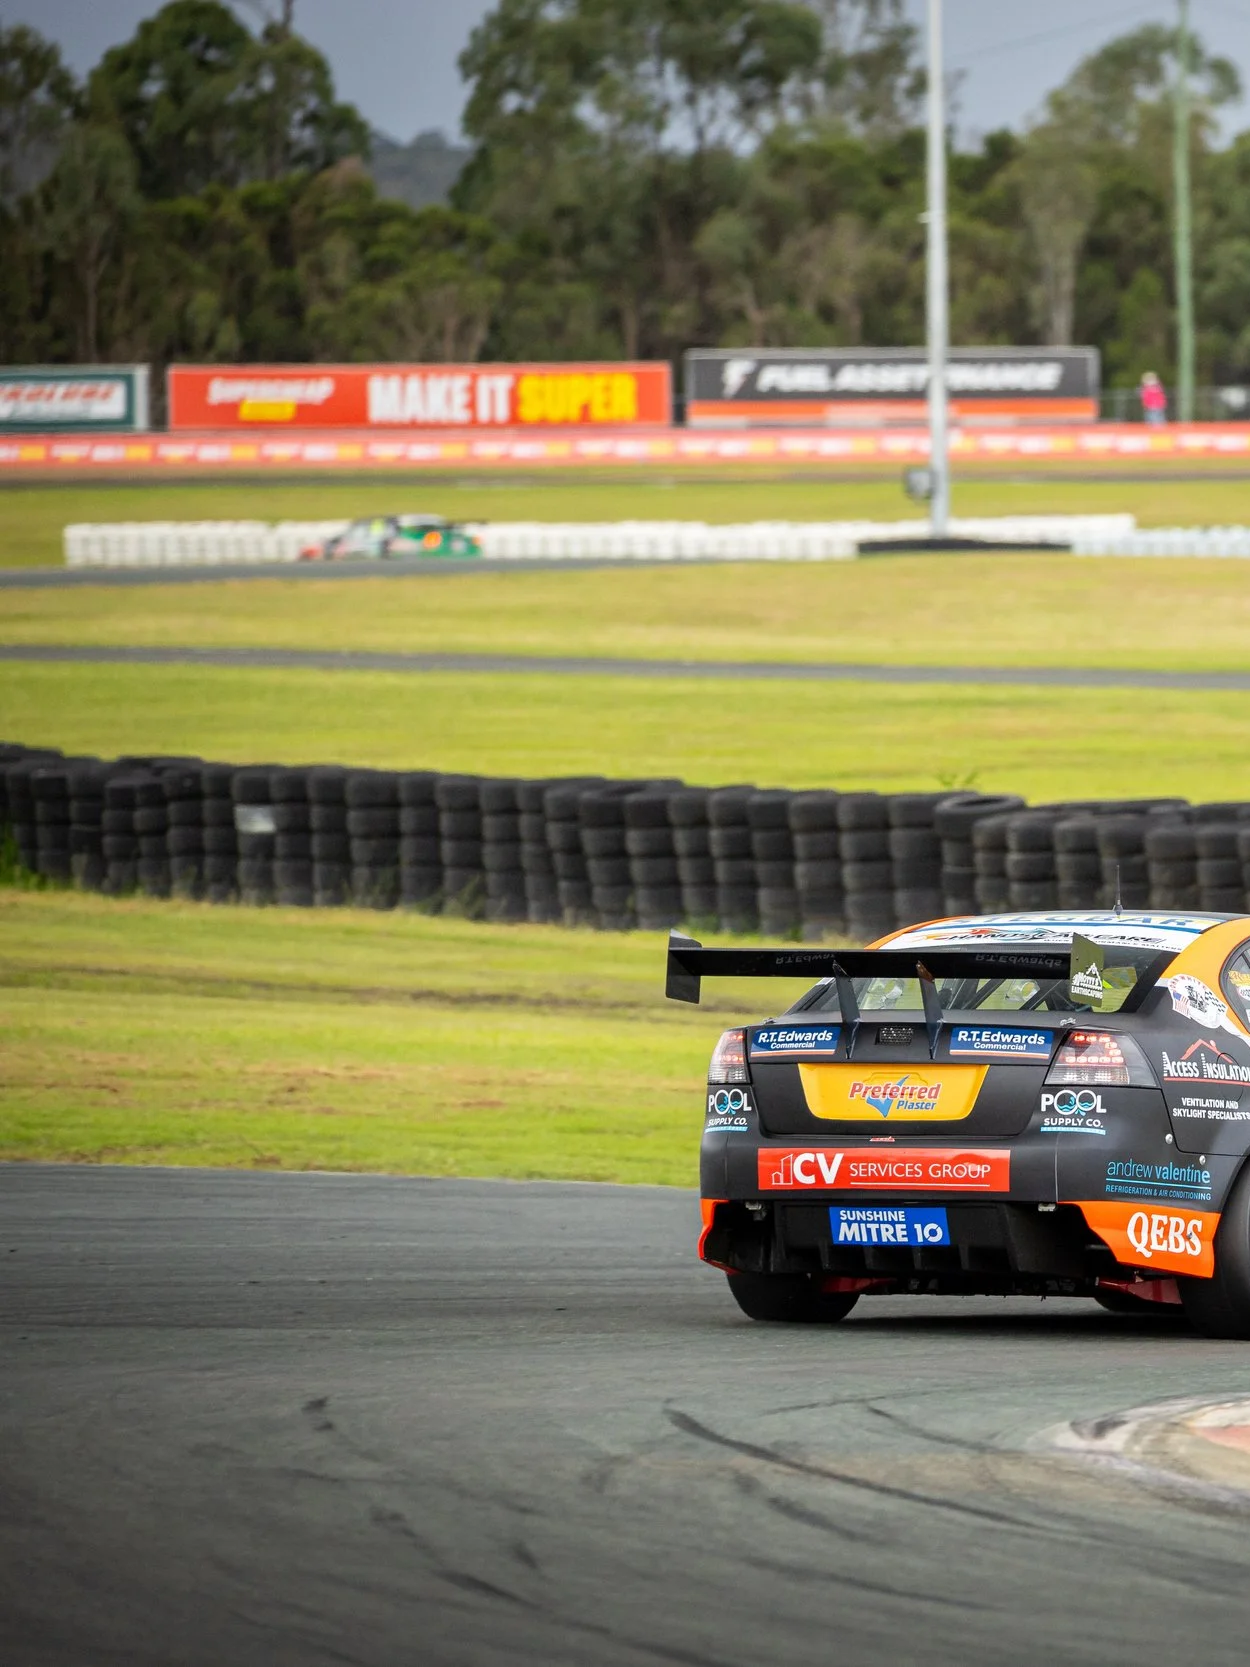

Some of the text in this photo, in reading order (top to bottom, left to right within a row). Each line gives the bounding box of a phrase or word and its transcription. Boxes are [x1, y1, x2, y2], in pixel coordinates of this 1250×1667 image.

[367, 372, 638, 424] MAKE IT SUPER
[757, 1029, 833, 1043] R.T.Edwards
[957, 1030, 1046, 1046] R.T.Edwards
[770, 1041, 816, 1050] Commercial
[973, 1041, 1026, 1051] Commercial
[1162, 1051, 1200, 1078] ACCESS
[849, 1081, 942, 1101] Preferred
[708, 1088, 752, 1115] POOL
[896, 1100, 938, 1112] Plaster
[1040, 1089, 1107, 1116] POOL
[1181, 1097, 1239, 1110] VENTILATION AND
[1172, 1107, 1207, 1119] SKYLIGHT
[707, 1117, 748, 1127] SUPPLY CO.
[1043, 1117, 1104, 1128] SUPPLY CO.
[793, 1152, 844, 1185] CV
[850, 1162, 991, 1179] SERVICES GROUP
[1107, 1158, 1211, 1184] andrew valentine
[1105, 1184, 1153, 1197] REFRIGERATION
[1158, 1189, 1168, 1198] AIR
[1168, 1190, 1212, 1201] CONDITIONING
[839, 1209, 906, 1222] SUNSHINE
[838, 1222, 944, 1244] MITRE 10
[1126, 1211, 1203, 1258] QEBS
